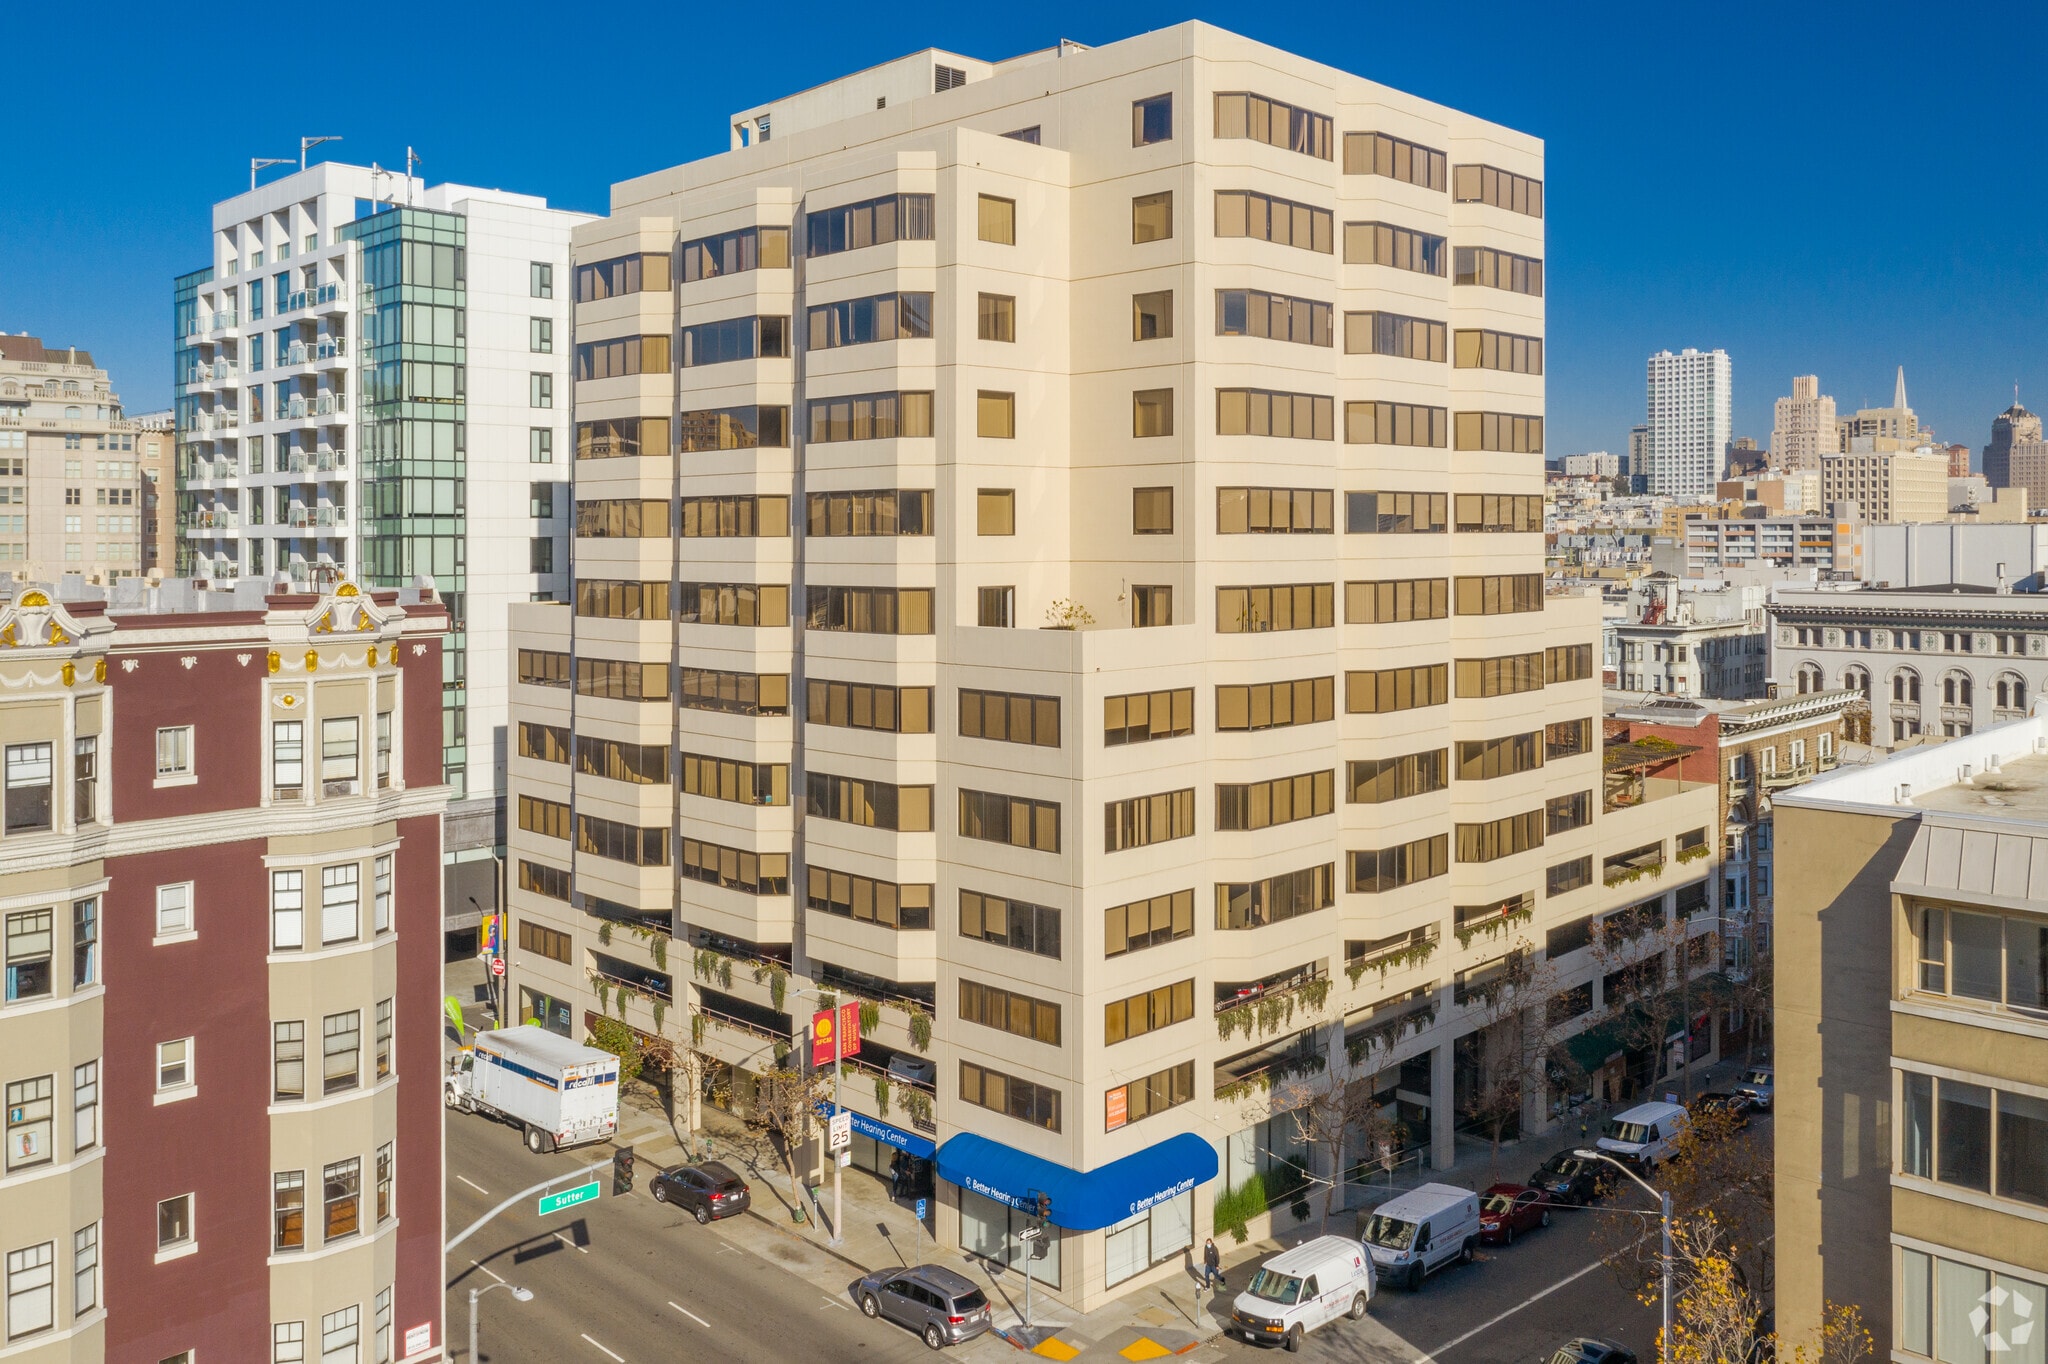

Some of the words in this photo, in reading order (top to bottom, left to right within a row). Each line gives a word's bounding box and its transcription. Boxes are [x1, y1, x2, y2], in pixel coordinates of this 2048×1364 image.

[568, 1077, 596, 1089] recall
[832, 1115, 849, 1124] SPEED
[833, 1123, 848, 1132] LIMIT
[832, 1130, 849, 1146] 25
[860, 1120, 886, 1140] Hearing
[886, 1129, 908, 1146] Center
[555, 1191, 585, 1207] Sutter
[972, 1179, 991, 1194] Better
[990, 1187, 1015, 1206] Hearing
[1015, 1197, 1036, 1212] Center
[1136, 1196, 1154, 1211] Better
[1154, 1185, 1177, 1203] Hearing
[1176, 1177, 1195, 1192] Center
